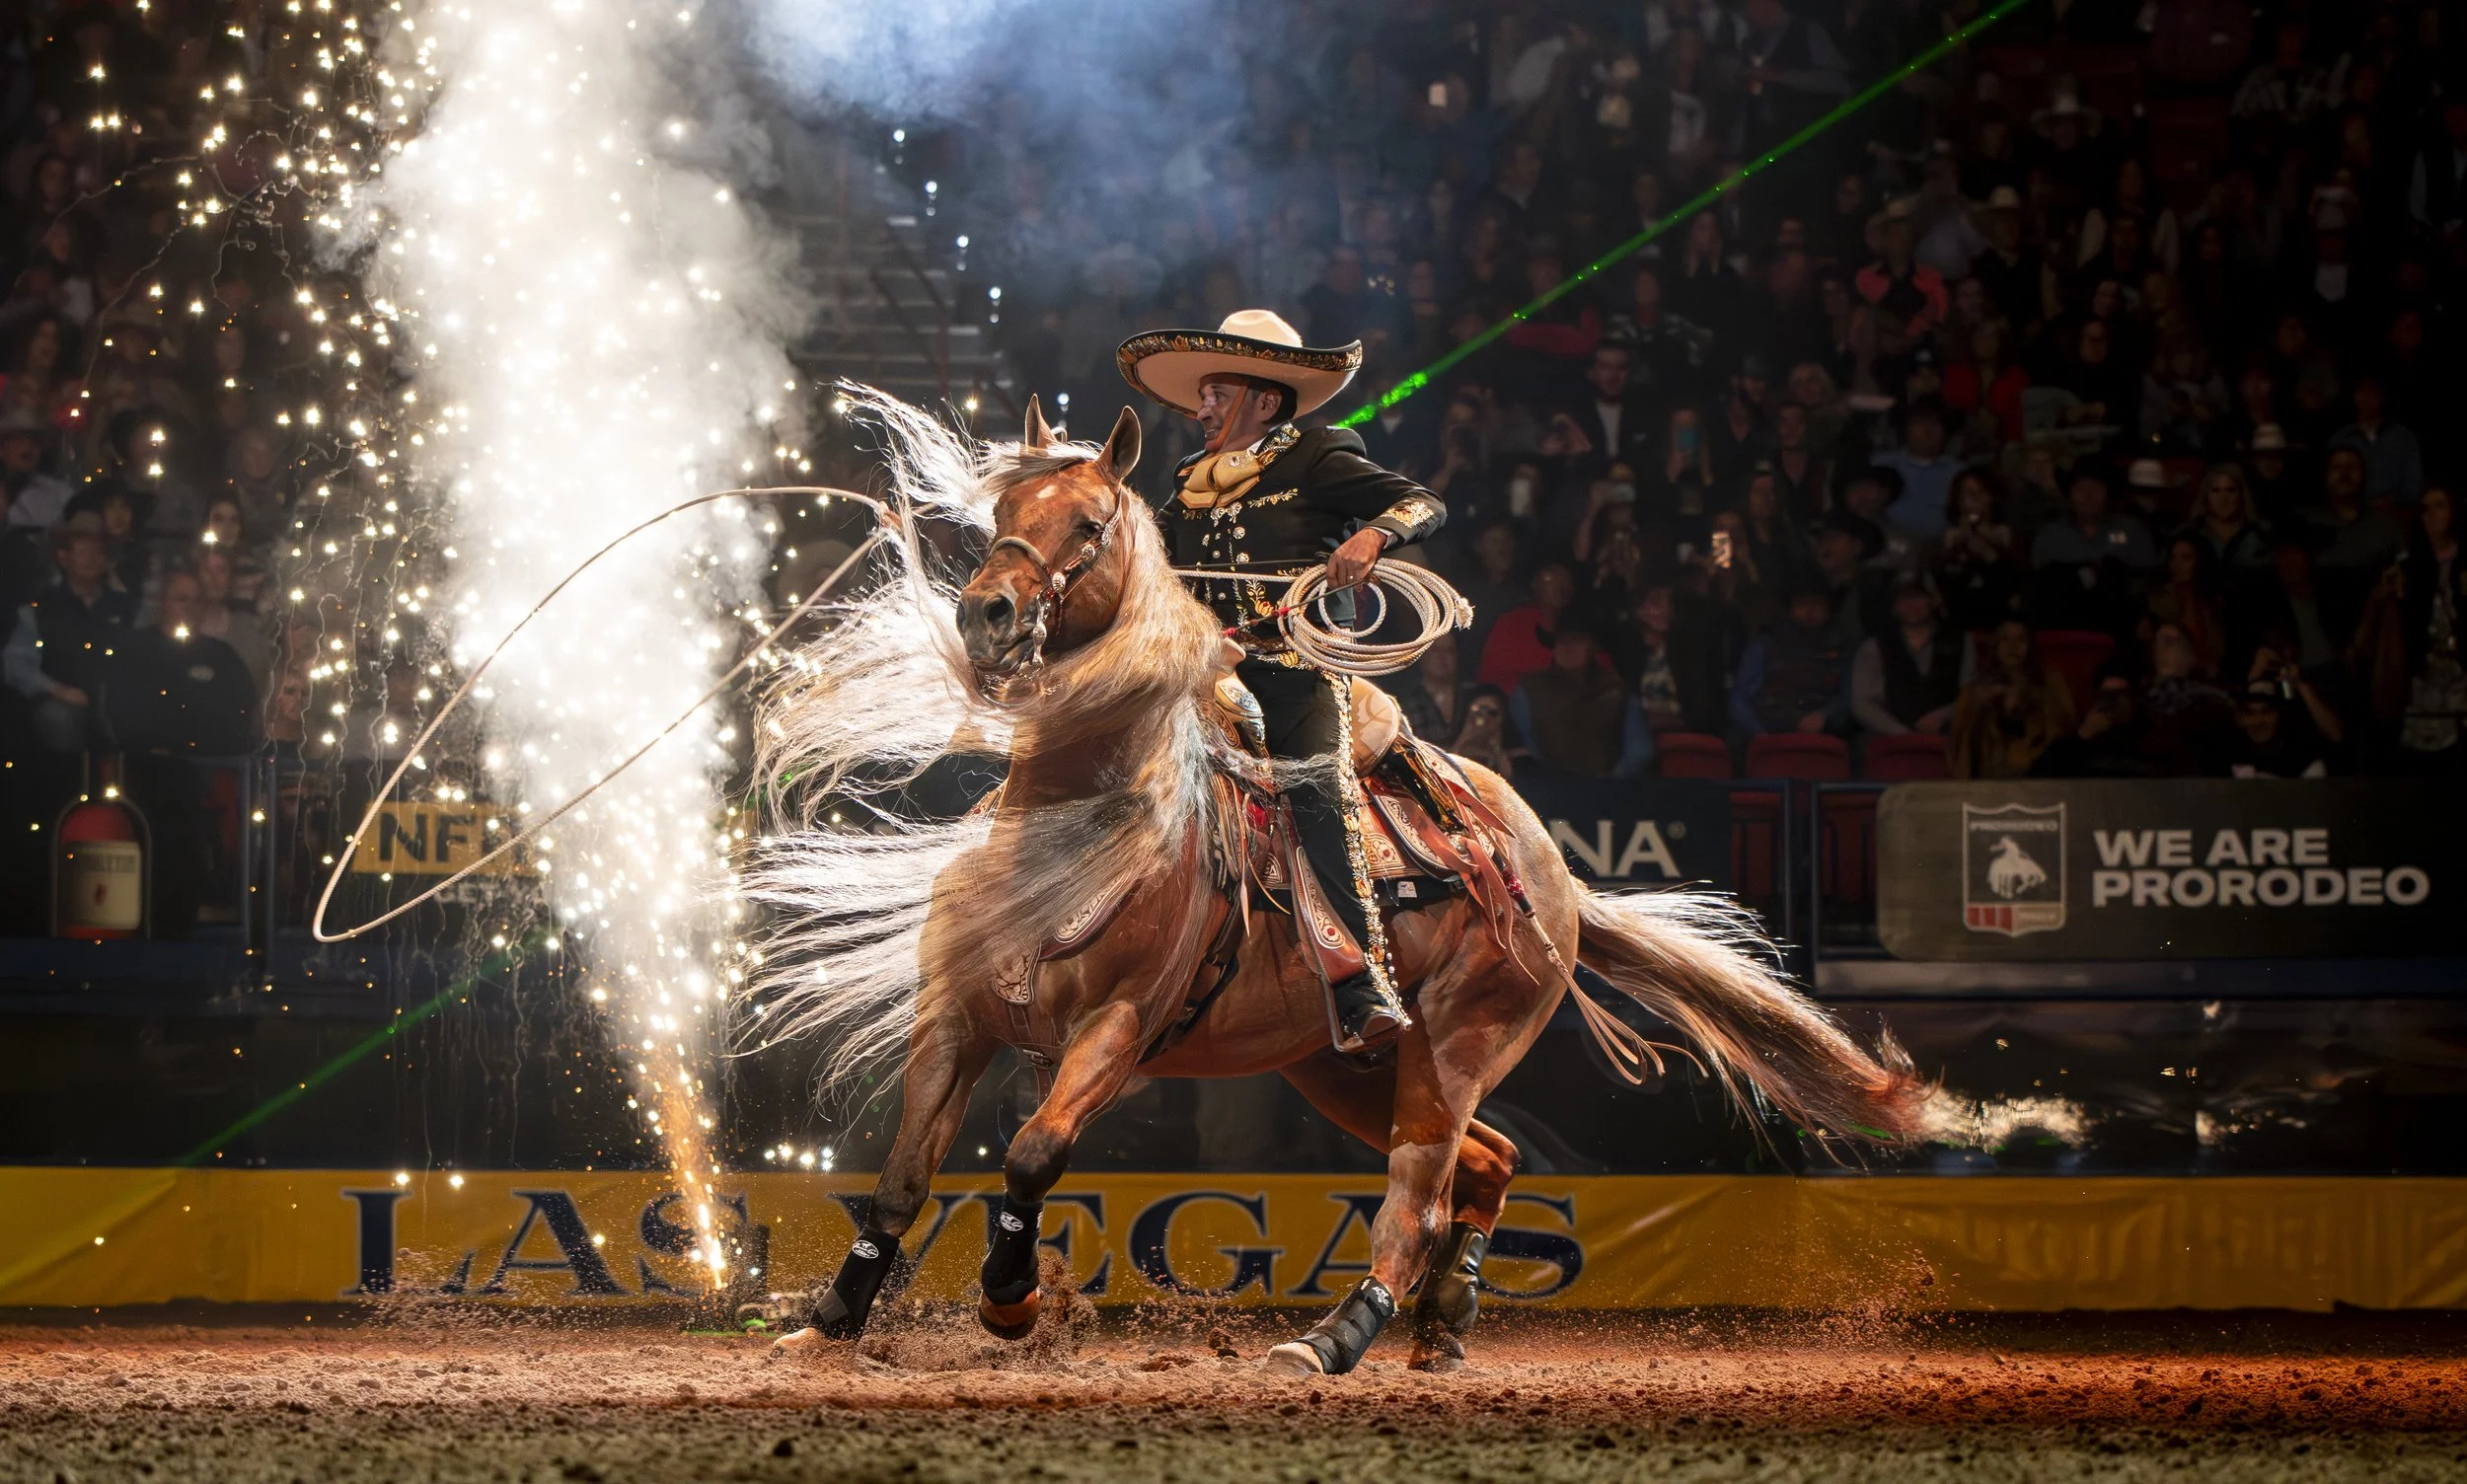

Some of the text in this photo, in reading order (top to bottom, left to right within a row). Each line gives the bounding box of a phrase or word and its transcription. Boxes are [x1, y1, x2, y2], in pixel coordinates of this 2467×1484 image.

[2093, 829, 2329, 867] WE ARE
[2092, 867, 2430, 908] PRORODEO
[341, 1187, 1586, 1302] LAS VEGAS
